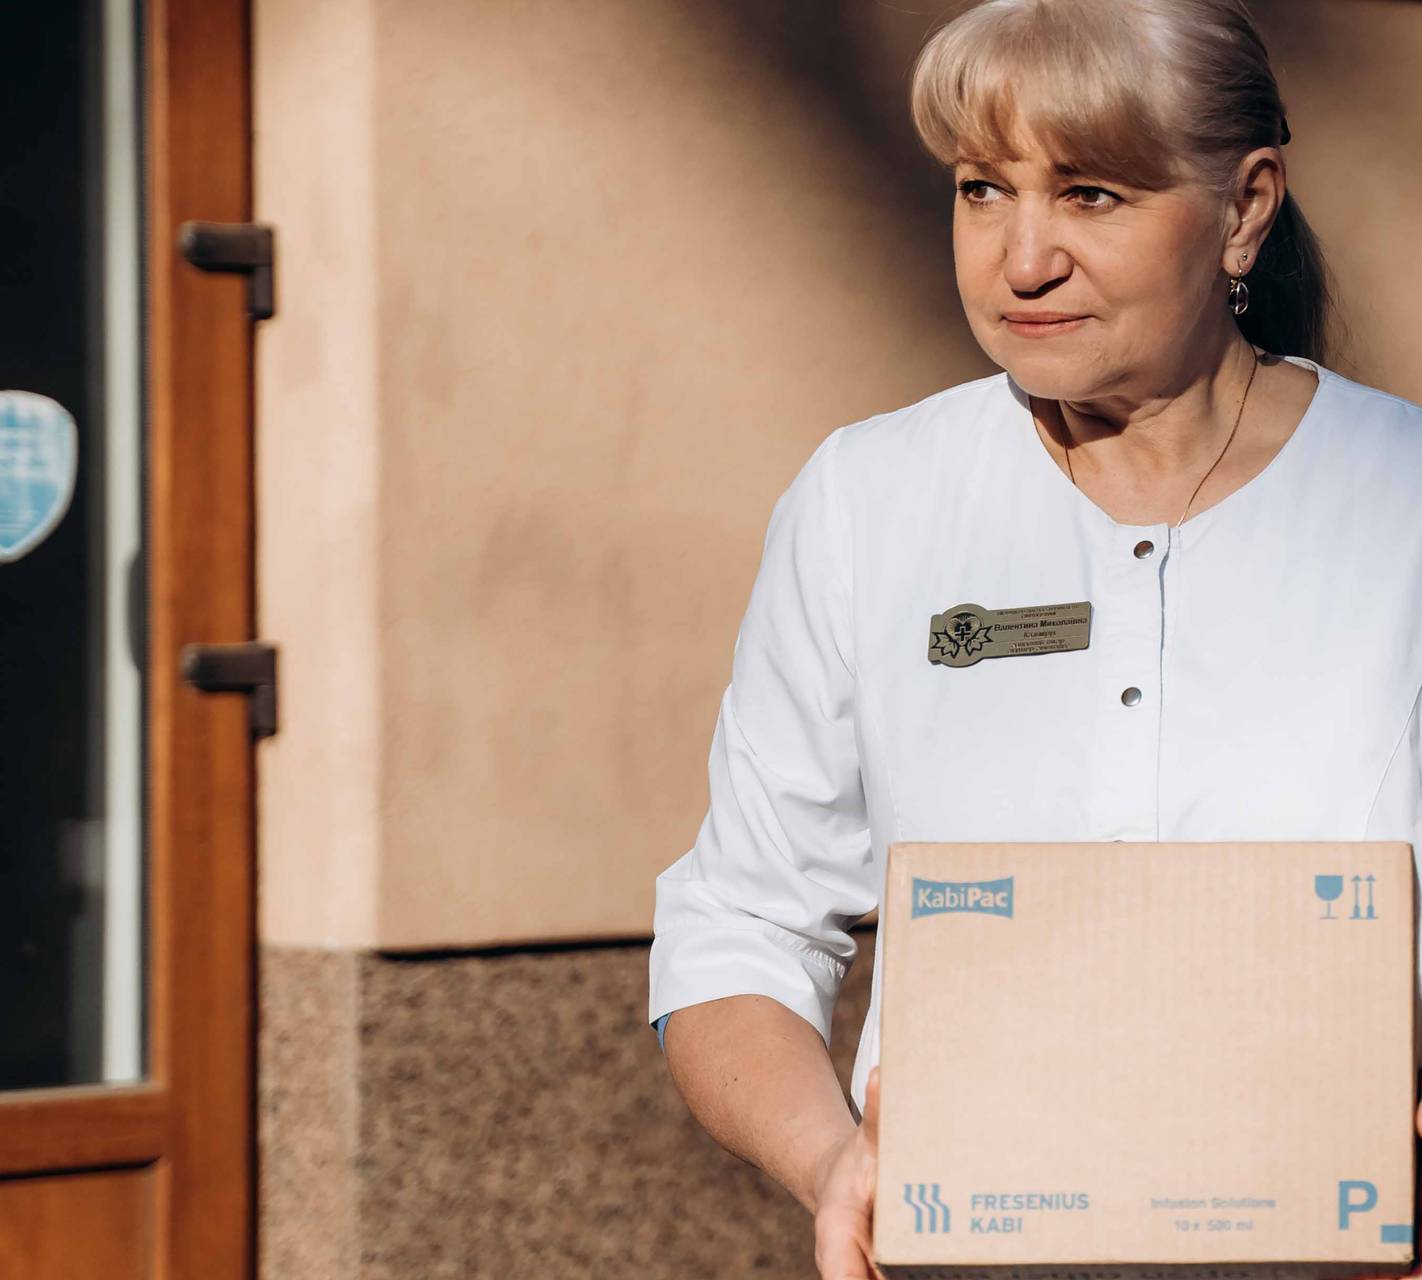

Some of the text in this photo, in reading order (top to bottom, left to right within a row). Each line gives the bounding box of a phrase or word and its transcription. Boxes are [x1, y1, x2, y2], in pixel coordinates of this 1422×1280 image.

[918, 887, 1008, 908] KabiPac
[971, 1193, 1088, 1210] FRESENIUS
[1339, 1181, 1377, 1230] P
[971, 1217, 1022, 1233] KABI
[1174, 1220, 1190, 1232] 10
